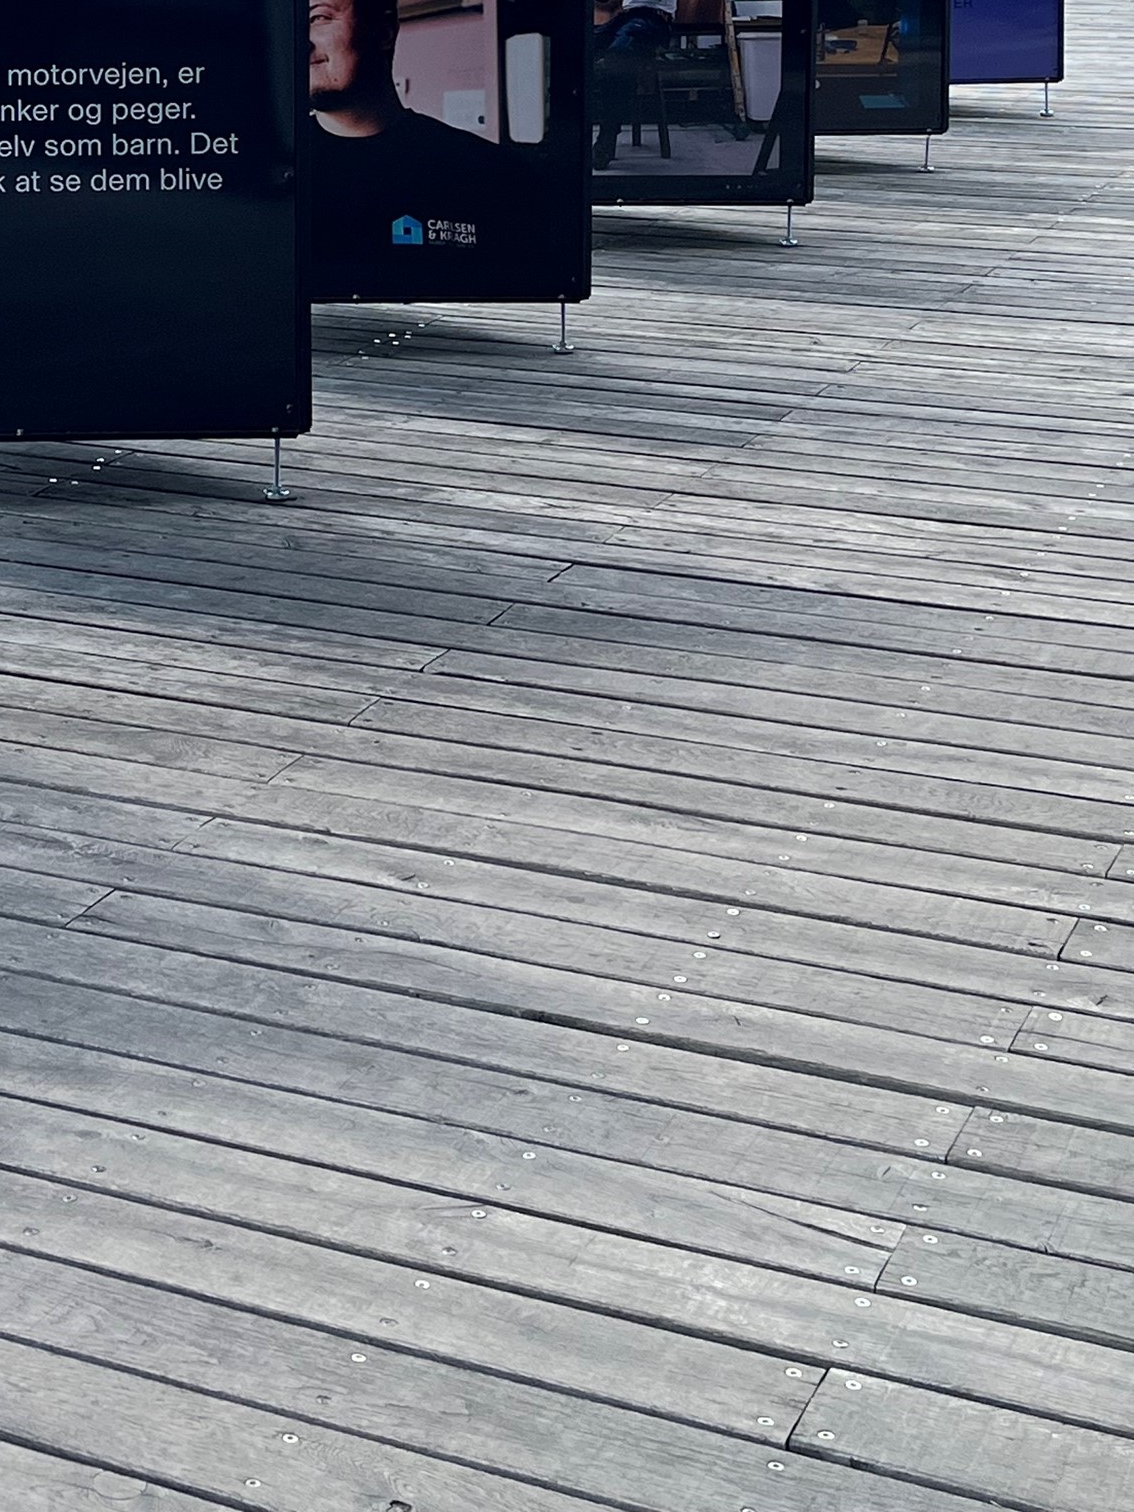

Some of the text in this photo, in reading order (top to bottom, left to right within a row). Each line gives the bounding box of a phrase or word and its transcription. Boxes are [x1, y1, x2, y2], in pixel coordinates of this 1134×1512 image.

[7, 61, 168, 90] motorvejen,
[178, 66, 206, 84] er
[67, 103, 102, 126] og
[112, 102, 196, 125] peger.
[44, 138, 102, 157] som
[112, 132, 180, 156] barn.
[190, 131, 239, 155] Det
[15, 170, 41, 193] at
[49, 174, 81, 192] se
[90, 168, 150, 192] dem
[160, 167, 223, 191] blive
[427, 219, 476, 234] CARLSEN
[440, 230, 477, 245] KRAGH
